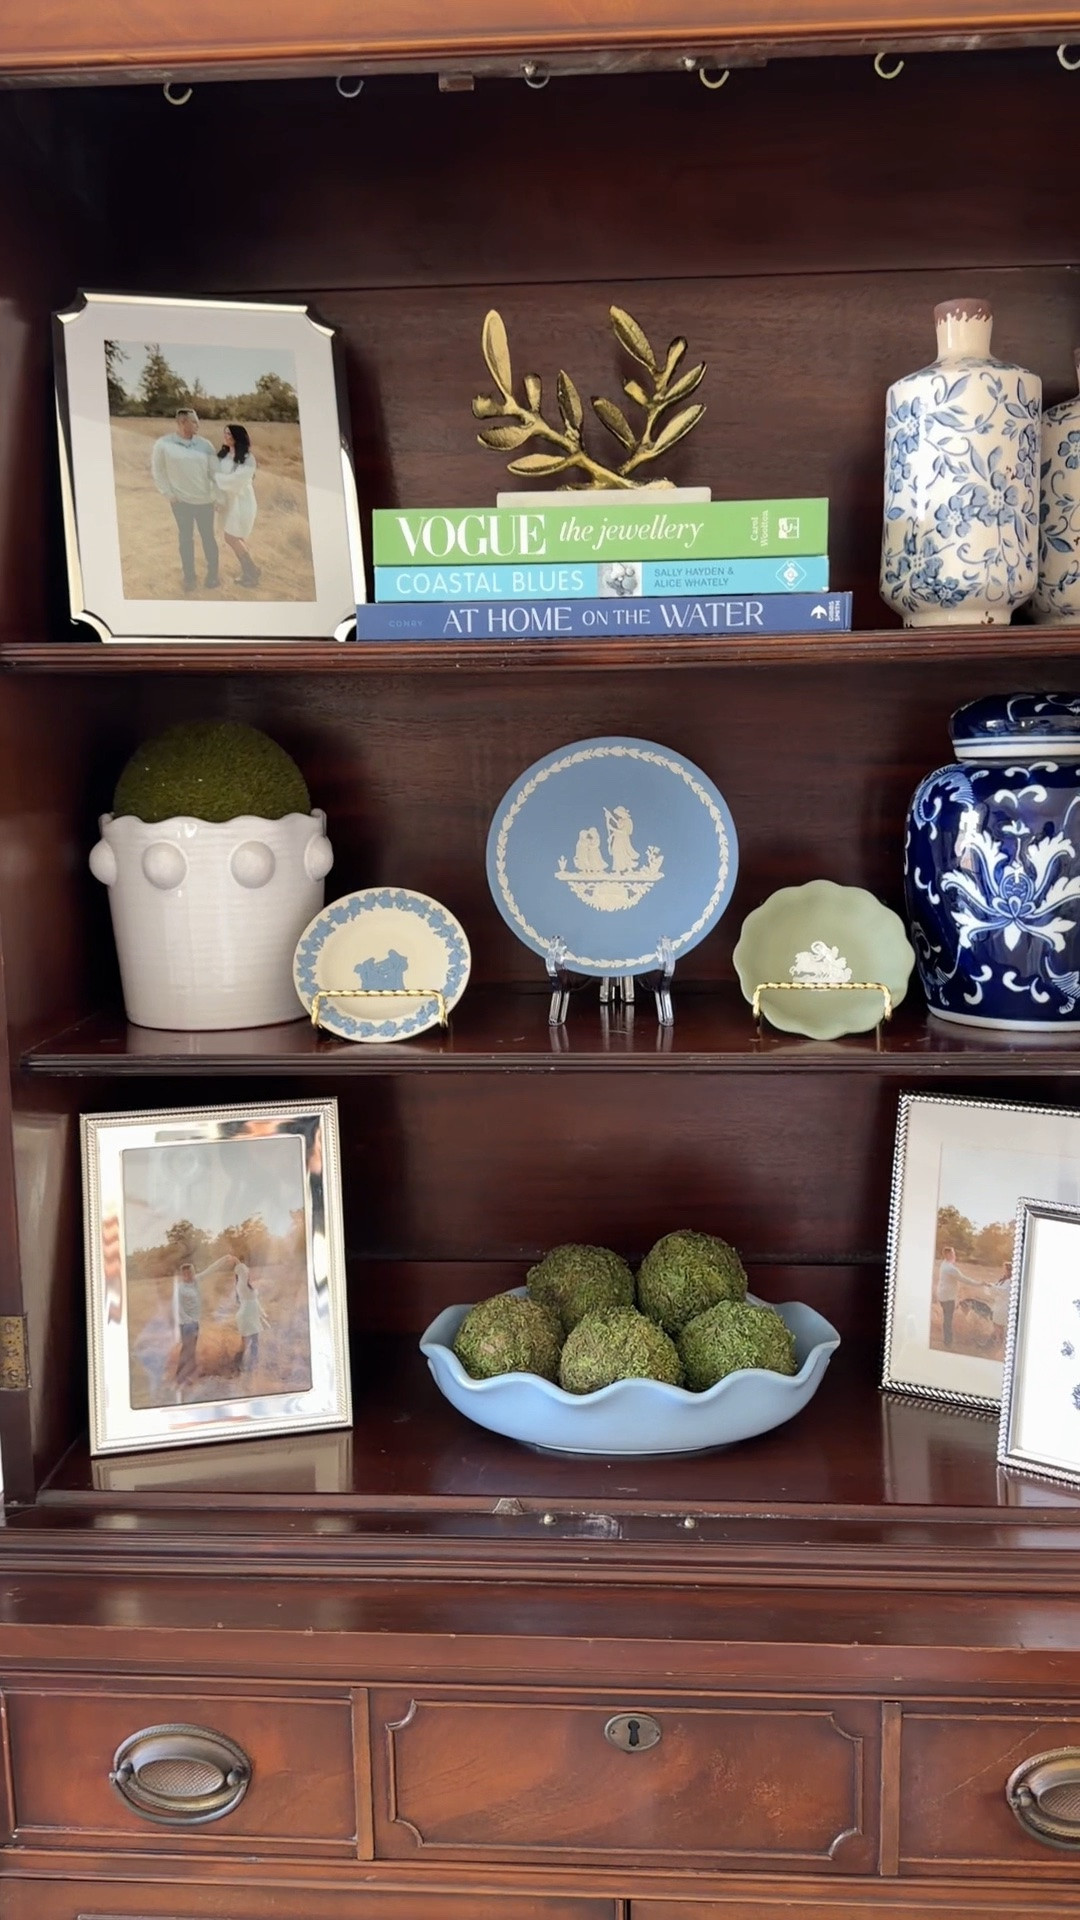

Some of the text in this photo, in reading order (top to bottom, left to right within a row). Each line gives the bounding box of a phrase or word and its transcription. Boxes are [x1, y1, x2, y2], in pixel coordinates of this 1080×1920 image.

[396, 514, 704, 557] VOGUE the jewellery
[750, 517, 758, 541] Carol
[396, 570, 584, 594] COASTAL BLUES
[654, 566, 734, 577] SALLY HAYDEN &
[654, 577, 729, 588] ALICE WHATELY
[443, 601, 764, 633] AT HOME ON THE WATER
